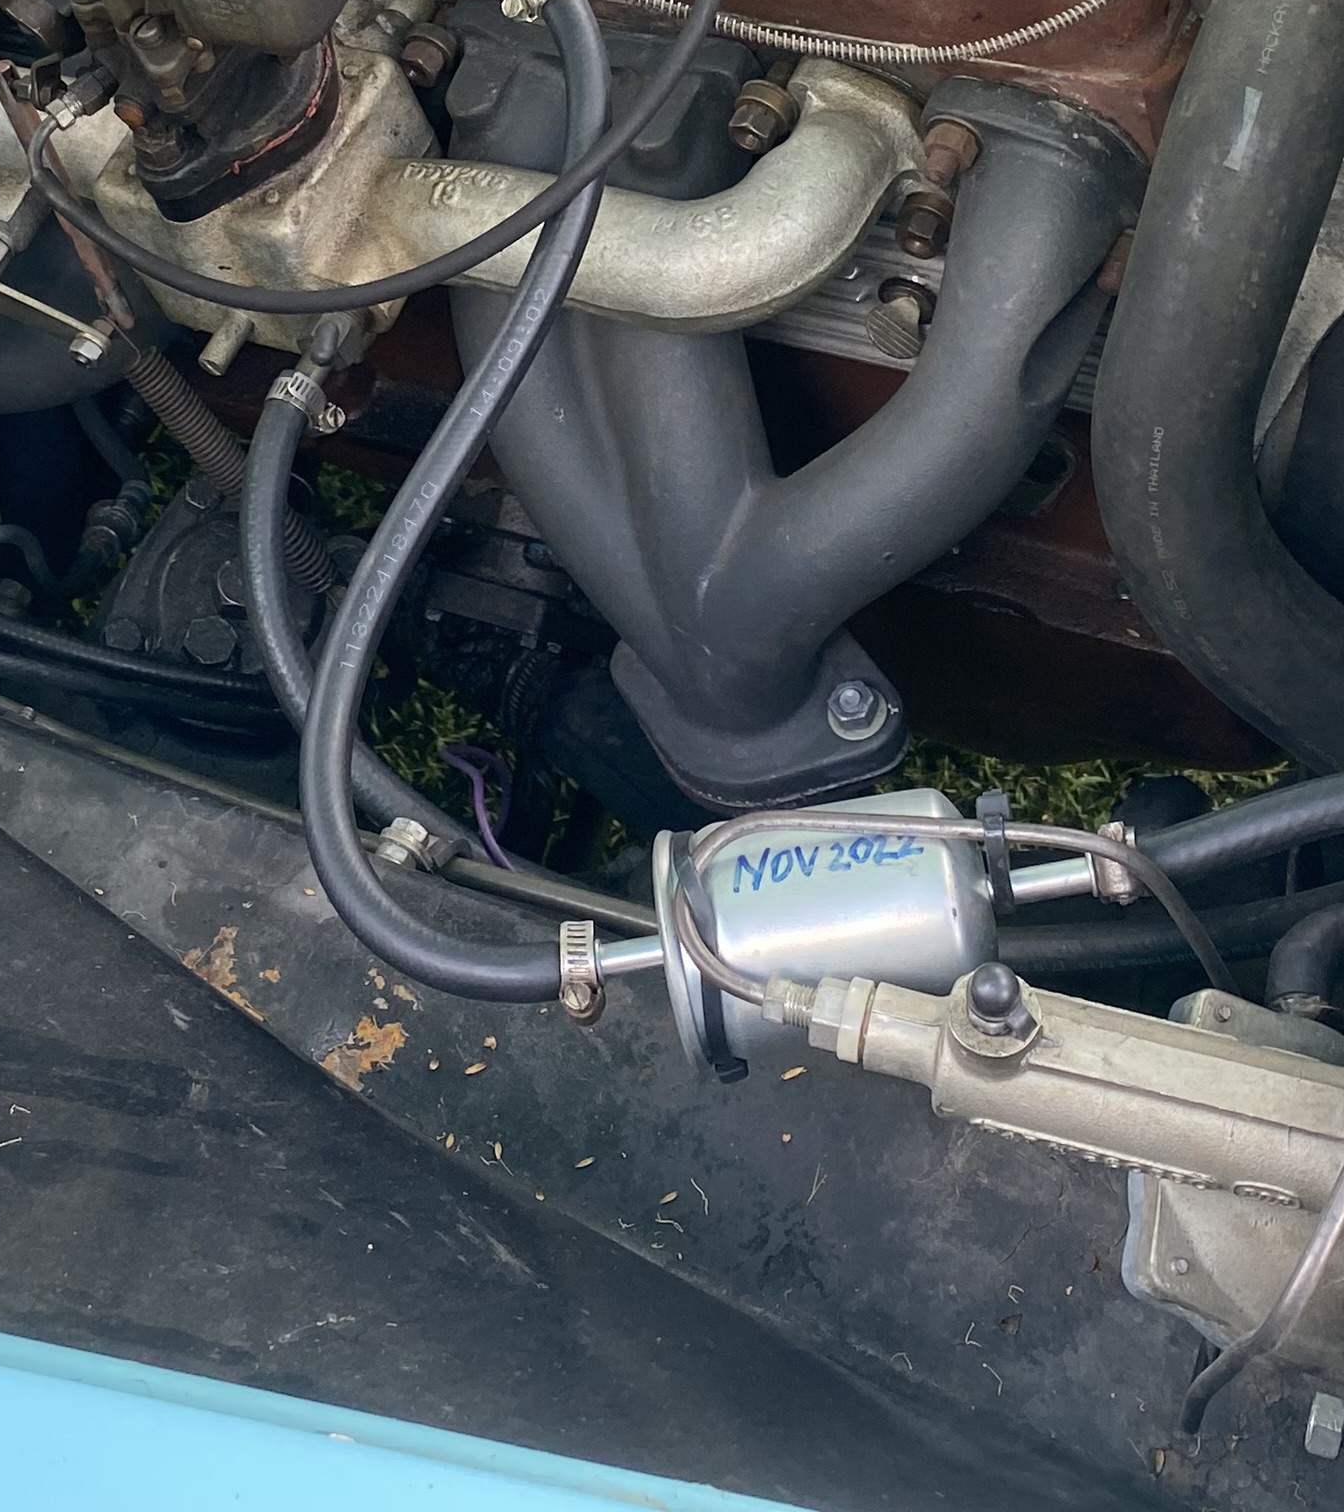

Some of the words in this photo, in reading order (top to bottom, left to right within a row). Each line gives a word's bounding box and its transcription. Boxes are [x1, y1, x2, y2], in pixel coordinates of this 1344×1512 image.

[469, 287, 552, 418] 14:09:02
[1148, 426, 1165, 494] THAILAND
[1149, 503, 1159, 518] IN
[1152, 525, 1168, 559] MADE
[732, 846, 820, 893] NOV
[828, 834, 924, 872] 2022
